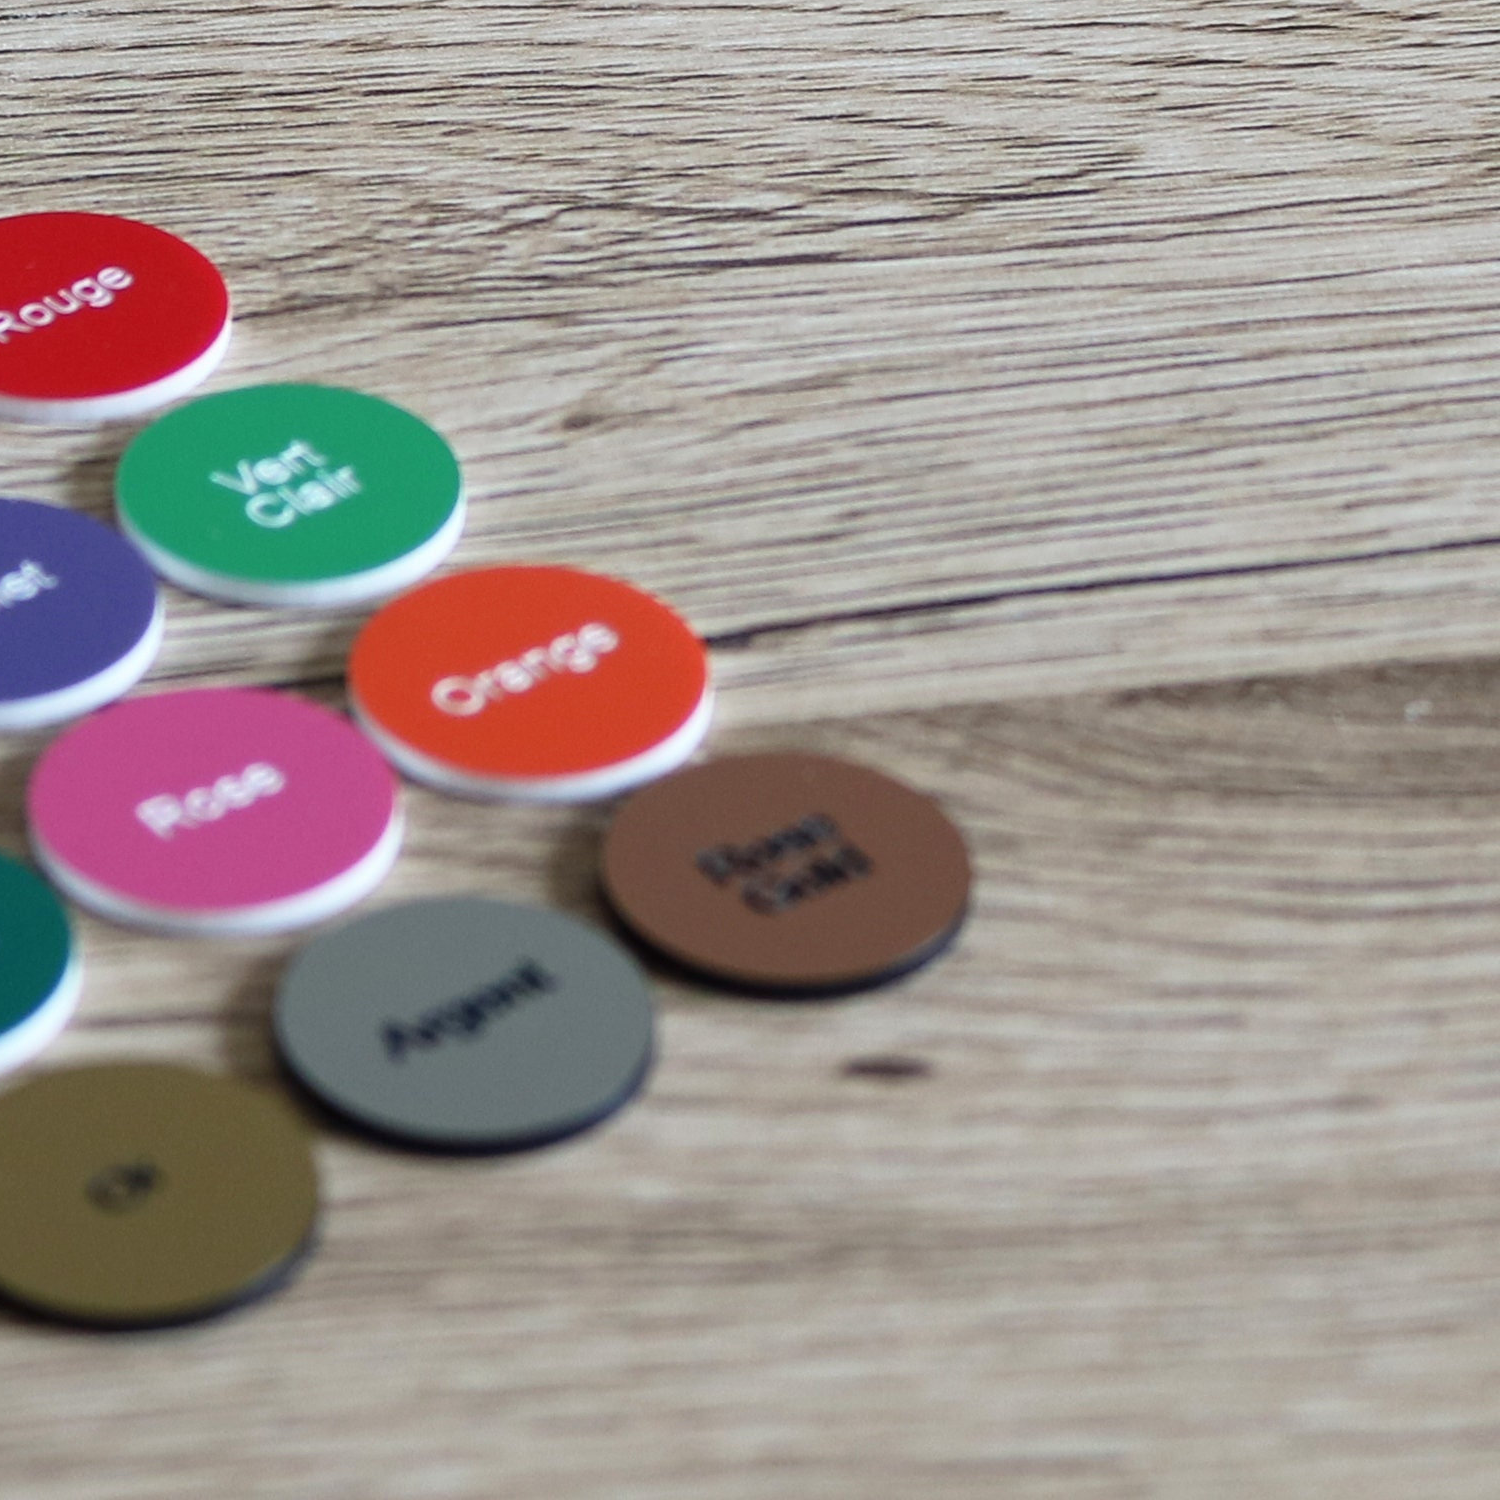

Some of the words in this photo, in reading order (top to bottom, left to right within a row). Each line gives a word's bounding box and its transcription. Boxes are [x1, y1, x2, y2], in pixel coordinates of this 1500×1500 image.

[209, 439, 328, 496] Vert
[244, 465, 363, 529] Clair
[430, 621, 620, 717] Orange
[135, 762, 286, 840] Rose
[380, 958, 560, 1063] Argent
